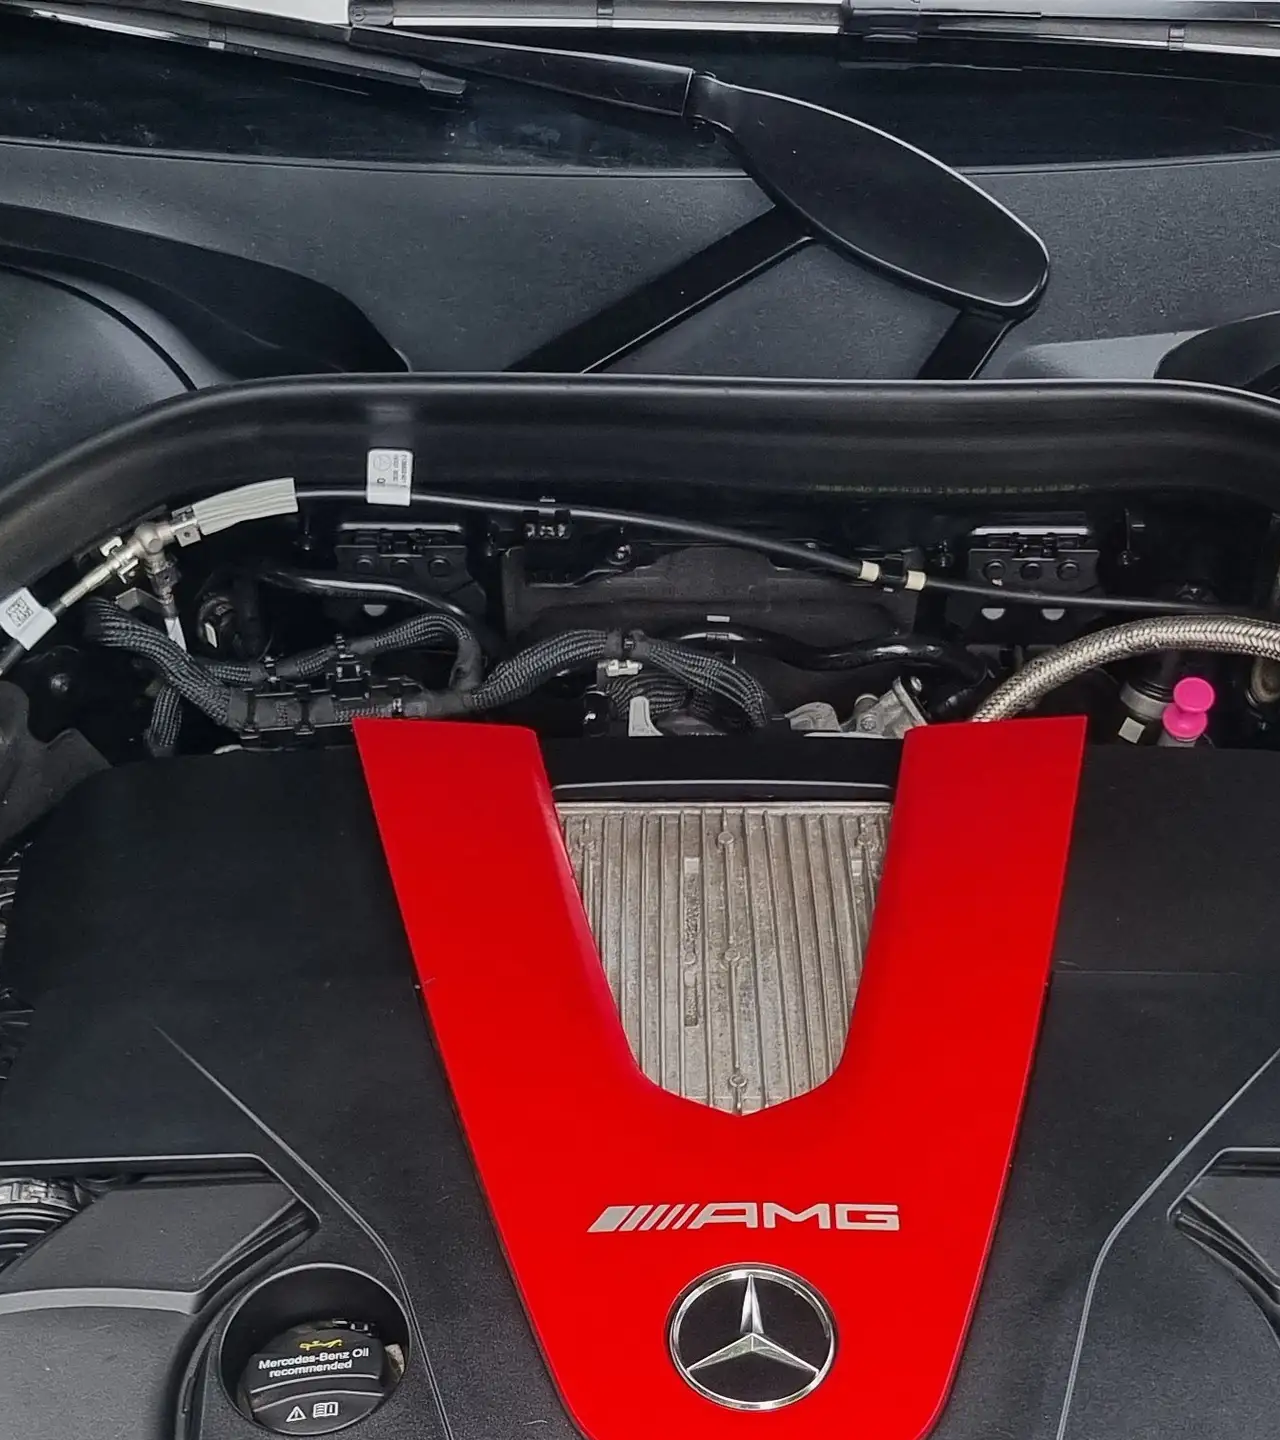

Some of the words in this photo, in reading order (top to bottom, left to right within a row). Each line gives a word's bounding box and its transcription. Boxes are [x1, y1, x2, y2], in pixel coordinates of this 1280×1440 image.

[687, 1202, 900, 1231] AMG
[258, 1351, 350, 1370] Mercedes-Benz
[352, 1347, 369, 1358] Oil
[269, 1359, 353, 1378] recommended
